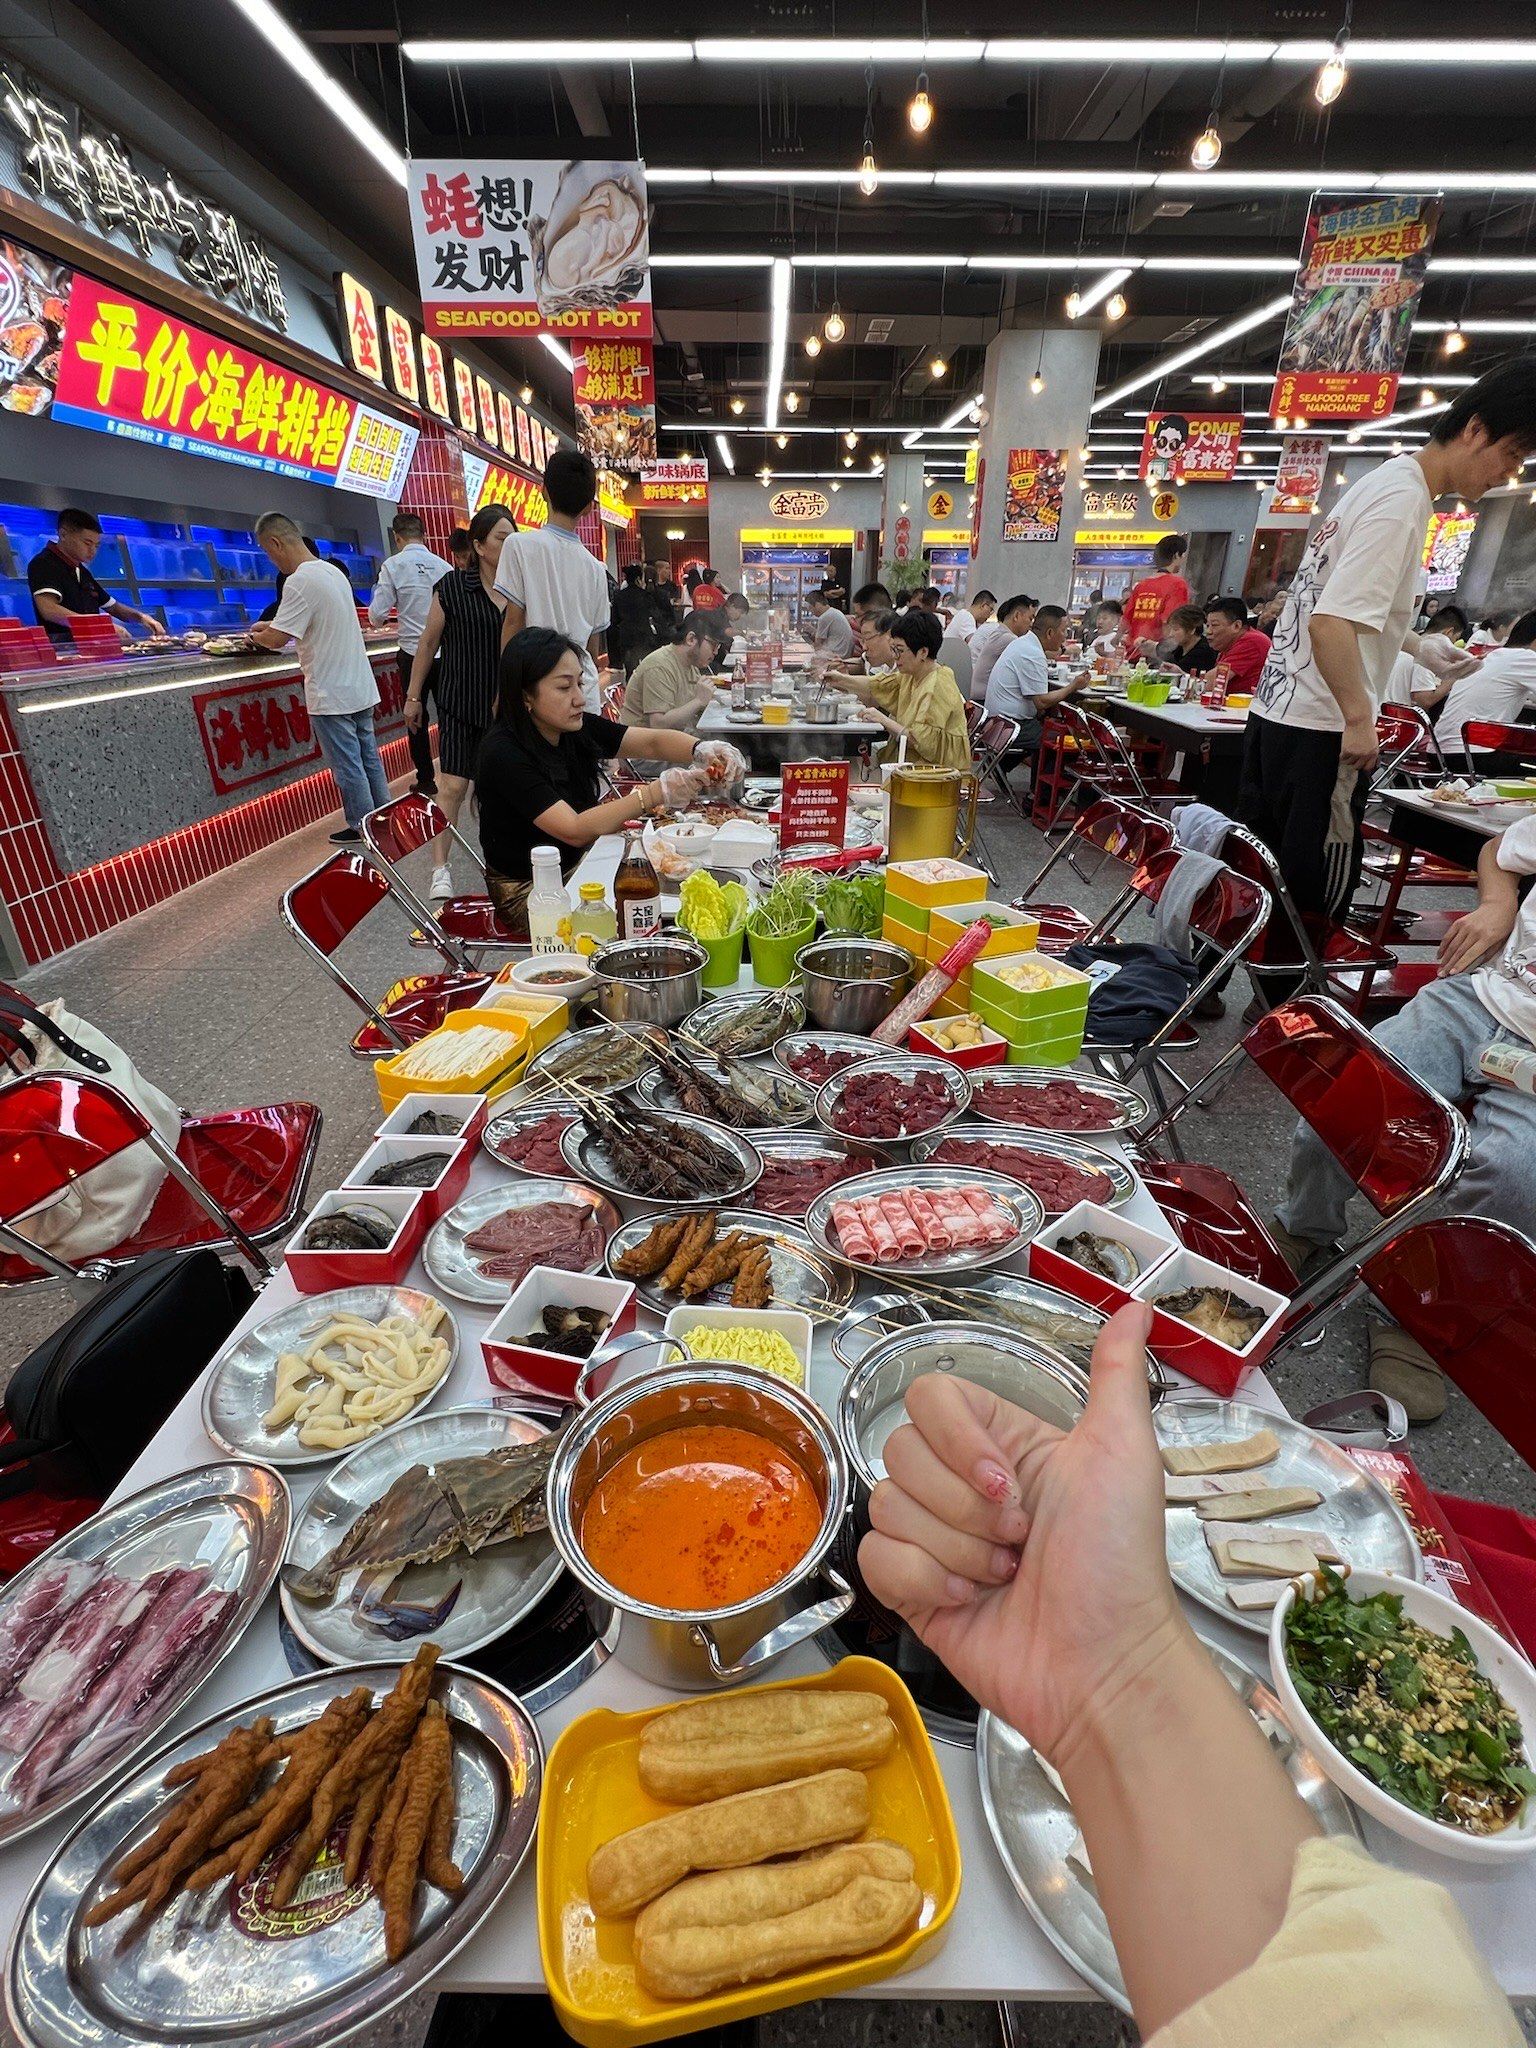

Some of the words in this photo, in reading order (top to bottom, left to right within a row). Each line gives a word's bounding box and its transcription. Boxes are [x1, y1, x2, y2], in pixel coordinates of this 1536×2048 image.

[421, 172, 533, 239] 蚝想!
[431, 241, 529, 294] 发财
[1344, 267, 1381, 276] CHINA
[436, 310, 540, 327] SEAFOOD
[547, 310, 591, 327] HOT
[597, 310, 642, 327] POT
[76, 300, 351, 468] 平价海鲜排档
[1299, 393, 1344, 403] SEAFOOD
[1346, 393, 1371, 403] FREE
[1306, 403, 1361, 412] NANCHANG
[1149, 421, 1240, 435] WCOME
[1193, 432, 1232, 449] 人间
[774, 491, 825, 516] 金富贵
[933, 495, 950, 515] 金
